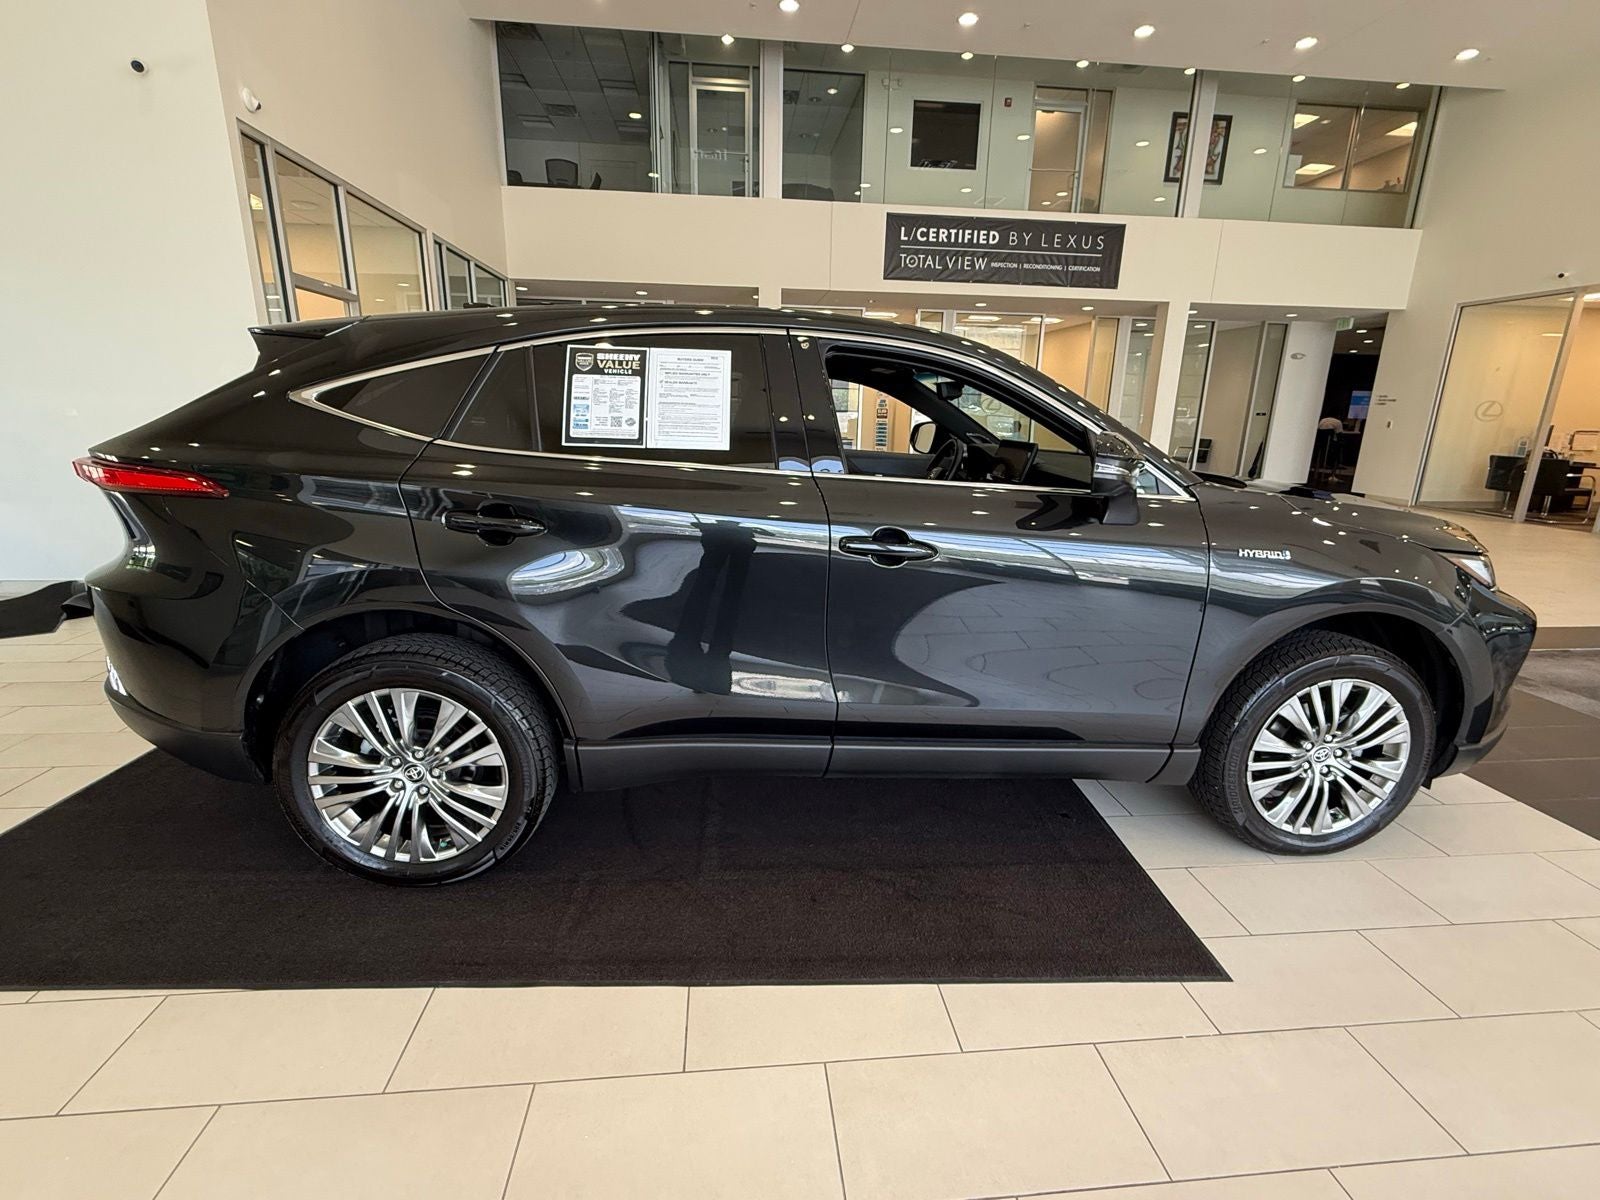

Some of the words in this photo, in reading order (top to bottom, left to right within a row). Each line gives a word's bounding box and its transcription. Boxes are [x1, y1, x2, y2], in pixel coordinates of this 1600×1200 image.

[900, 226, 1000, 245] L/CERTIFIED
[1008, 231, 1033, 246] BY
[1041, 233, 1105, 250] LEXUS
[596, 360, 641, 370] VALUE
[1238, 548, 1283, 560] HYBRID
